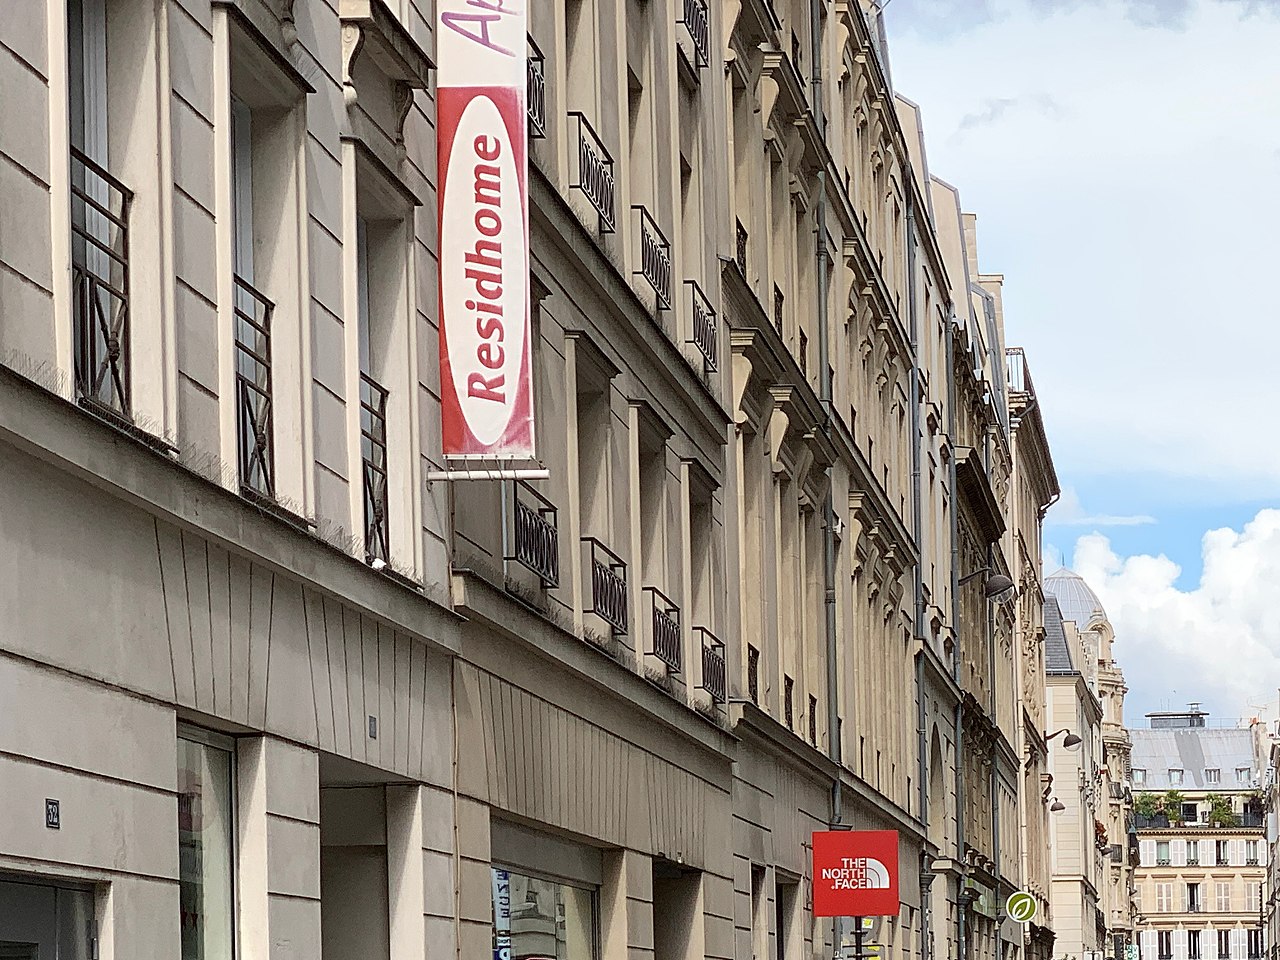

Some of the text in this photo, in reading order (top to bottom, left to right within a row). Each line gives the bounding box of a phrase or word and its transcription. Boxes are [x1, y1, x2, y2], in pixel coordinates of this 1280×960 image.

[464, 133, 506, 406] Residhome
[48, 803, 58, 823] 32
[841, 857, 866, 869] THE
[822, 868, 866, 880] NORTH
